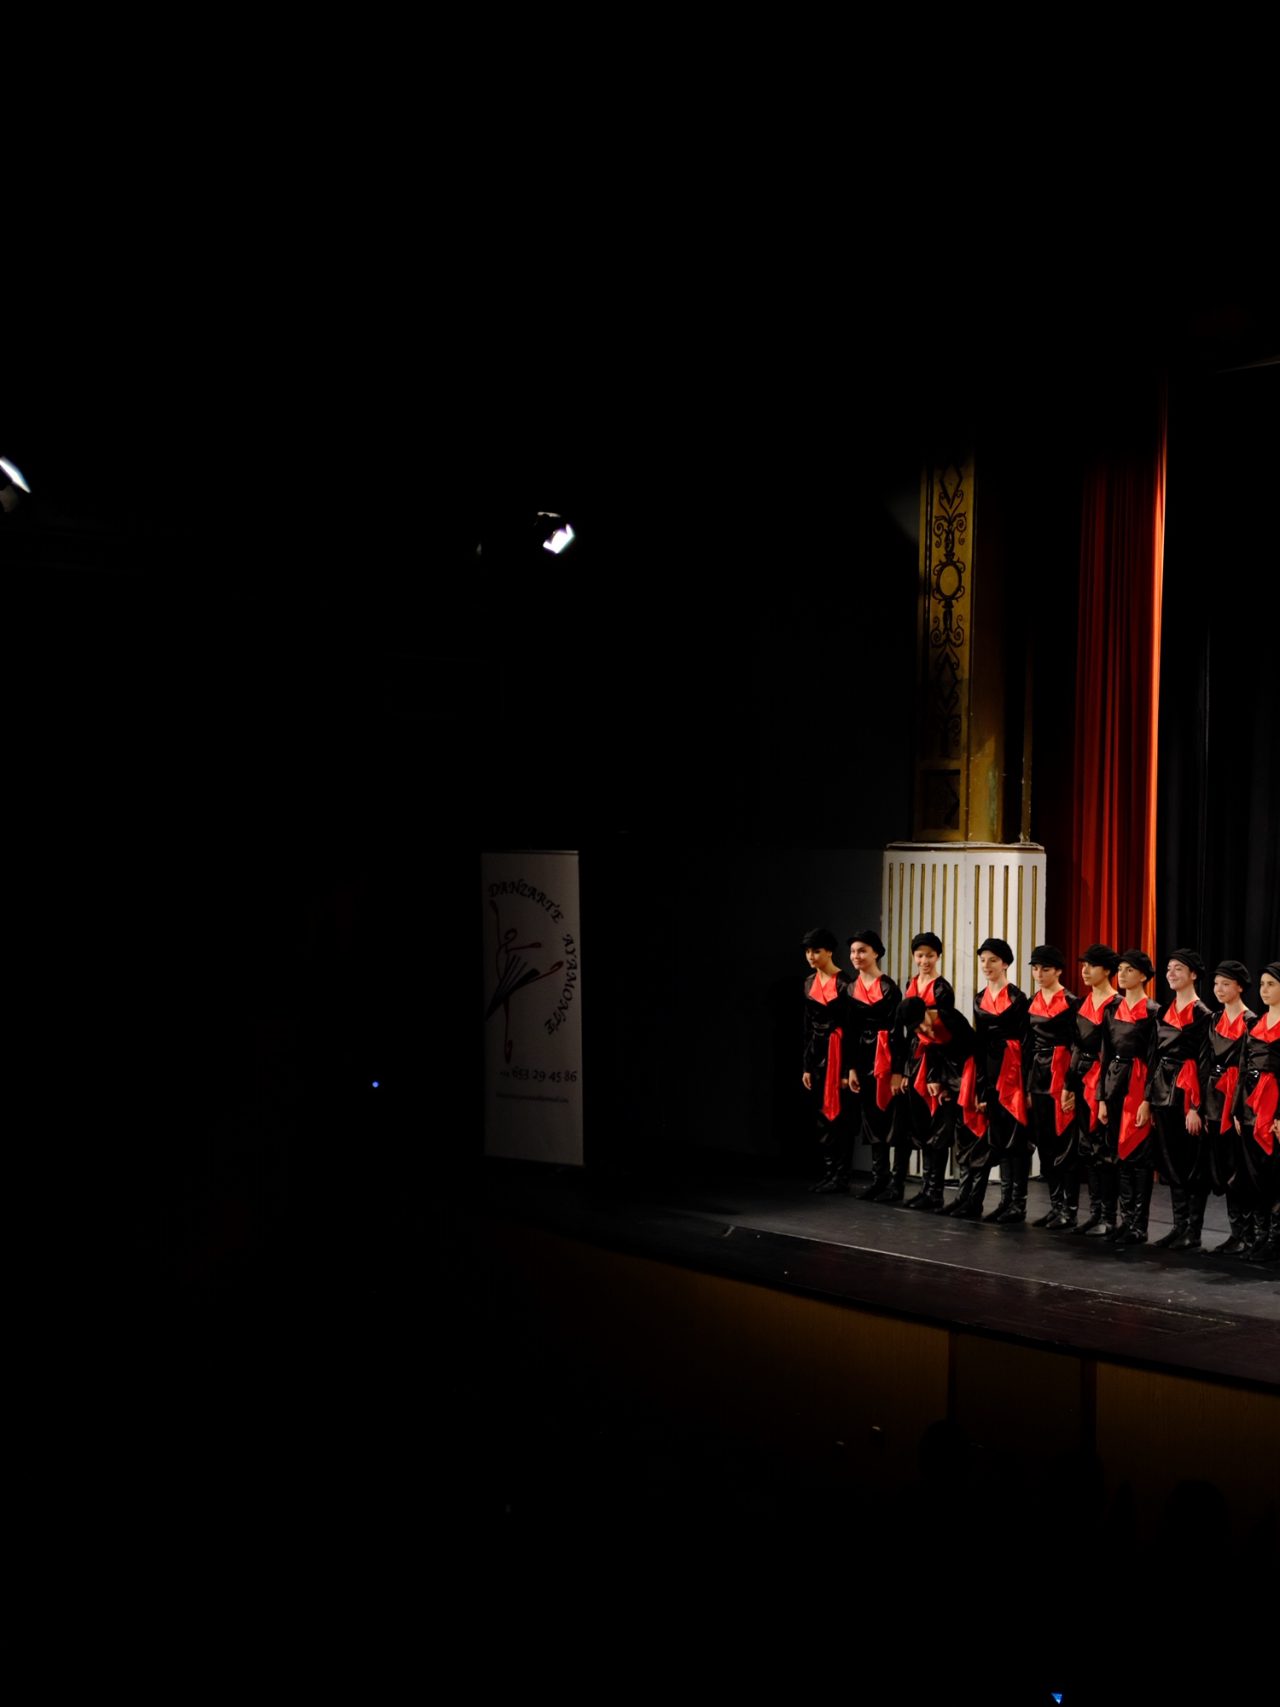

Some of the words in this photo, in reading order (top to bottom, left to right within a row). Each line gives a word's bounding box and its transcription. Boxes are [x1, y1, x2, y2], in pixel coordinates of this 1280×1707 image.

[488, 878, 564, 924] DANZARTE
[544, 934, 578, 1035] AYAMONTE
[532, 1069, 546, 1083] 29
[548, 1071, 562, 1083] 45
[564, 1070, 577, 1082] 86
